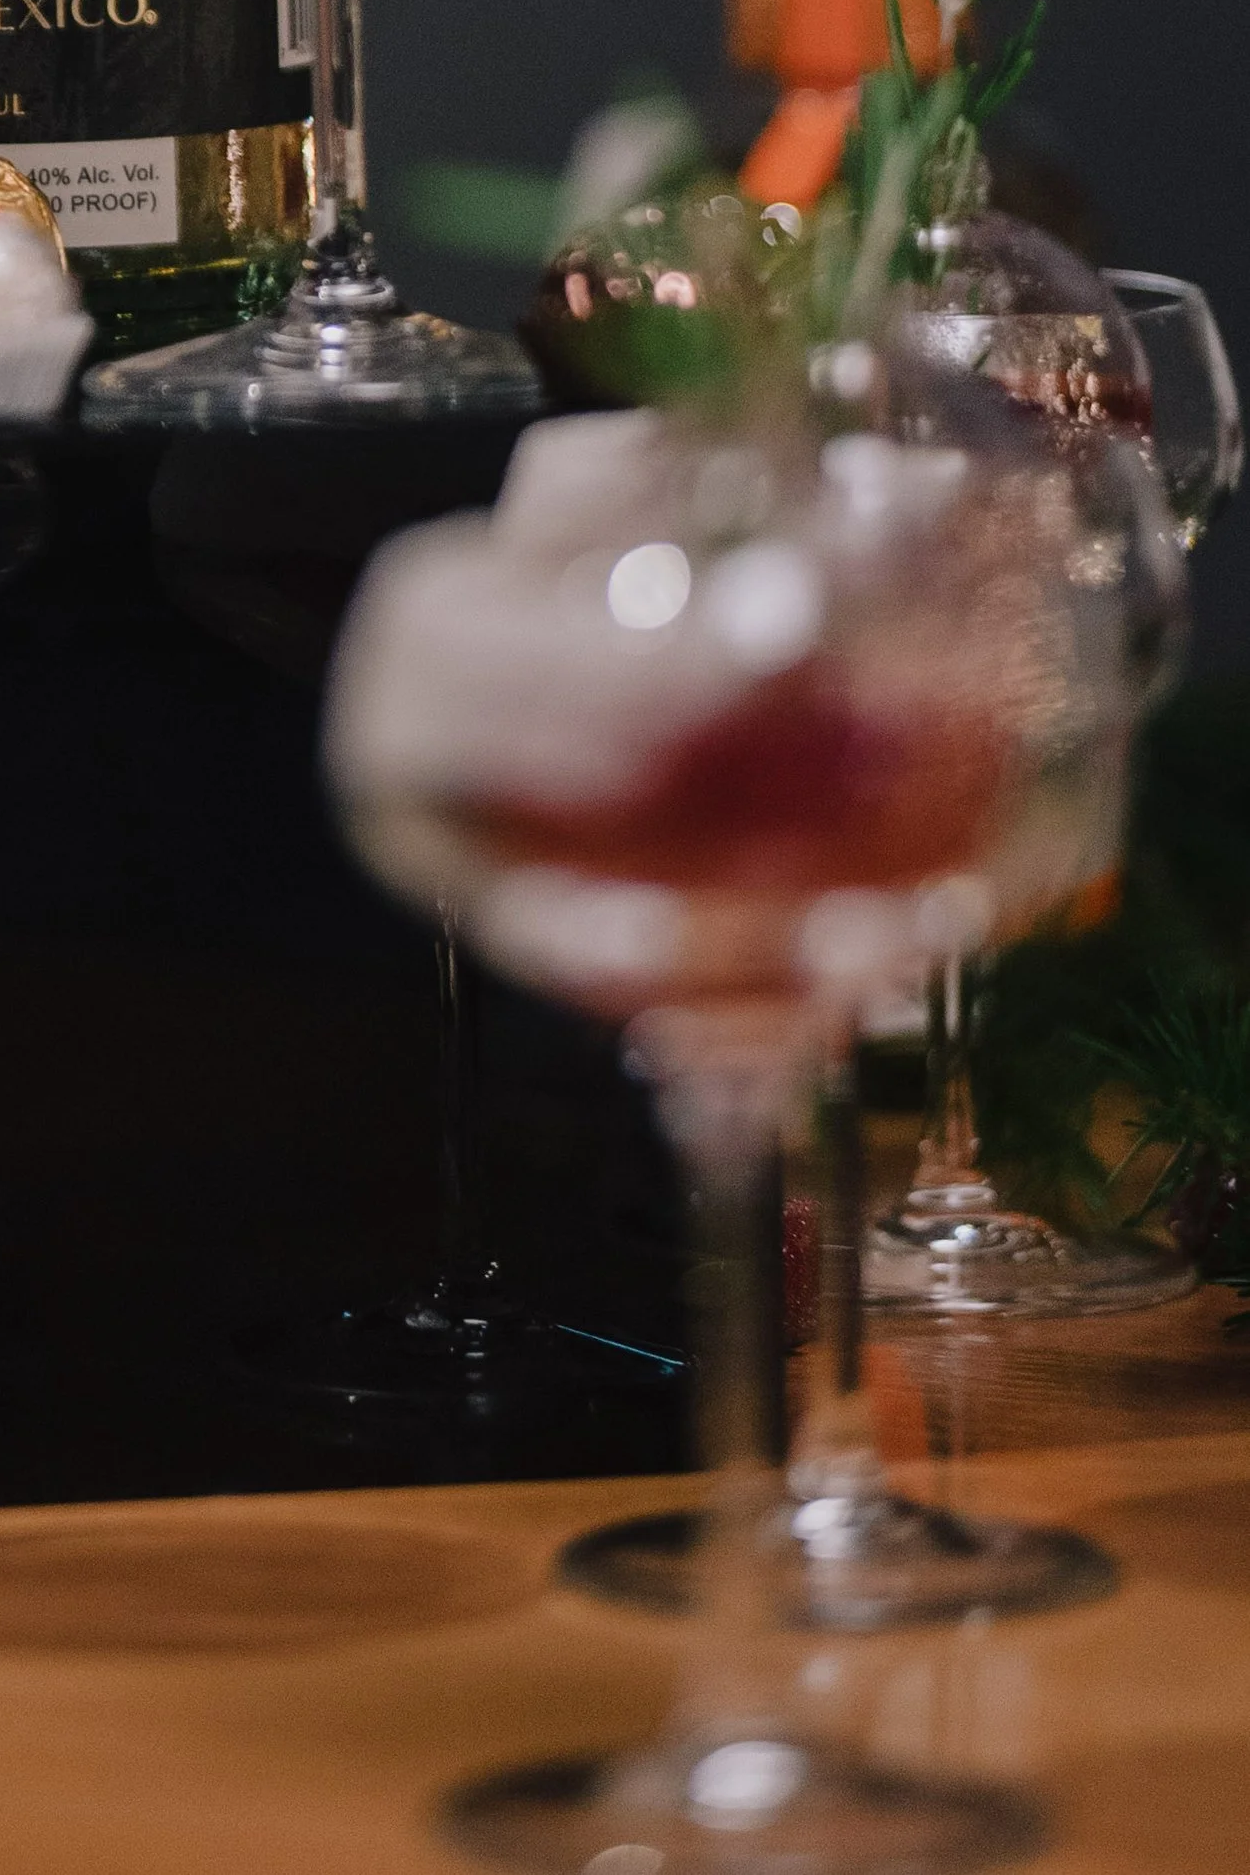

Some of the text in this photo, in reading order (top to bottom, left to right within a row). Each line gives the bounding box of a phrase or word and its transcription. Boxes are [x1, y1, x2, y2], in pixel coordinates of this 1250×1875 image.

[27, 164, 160, 187] 40% Alc. Vol.
[70, 190, 158, 213] PROOF)
